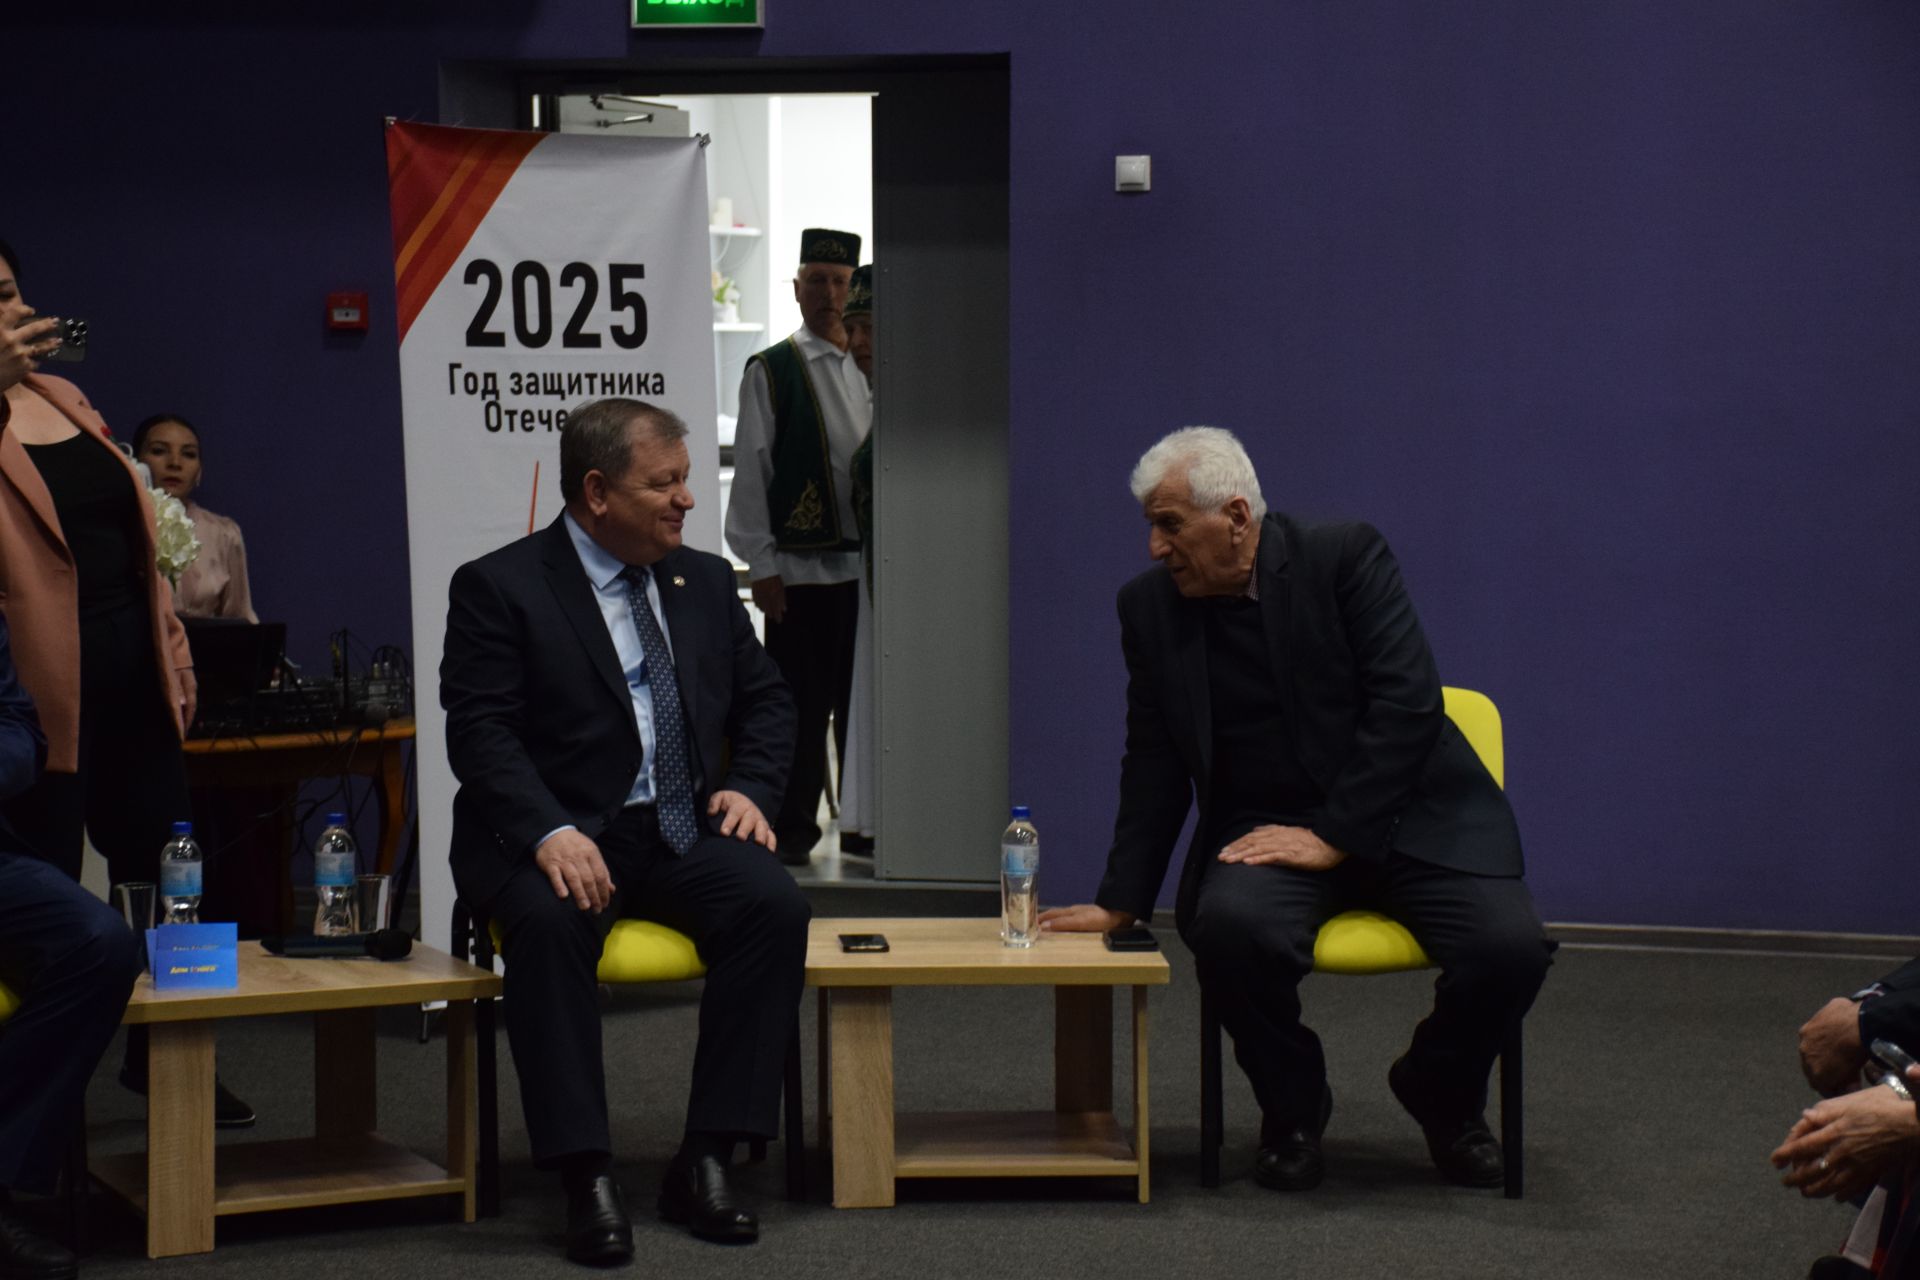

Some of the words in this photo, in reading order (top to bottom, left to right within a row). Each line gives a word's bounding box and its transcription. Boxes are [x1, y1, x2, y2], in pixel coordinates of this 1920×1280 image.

[464, 259, 648, 349] 2025
[449, 363, 500, 400] Год
[510, 372, 665, 400] защитника
[485, 401, 569, 433] Отече
